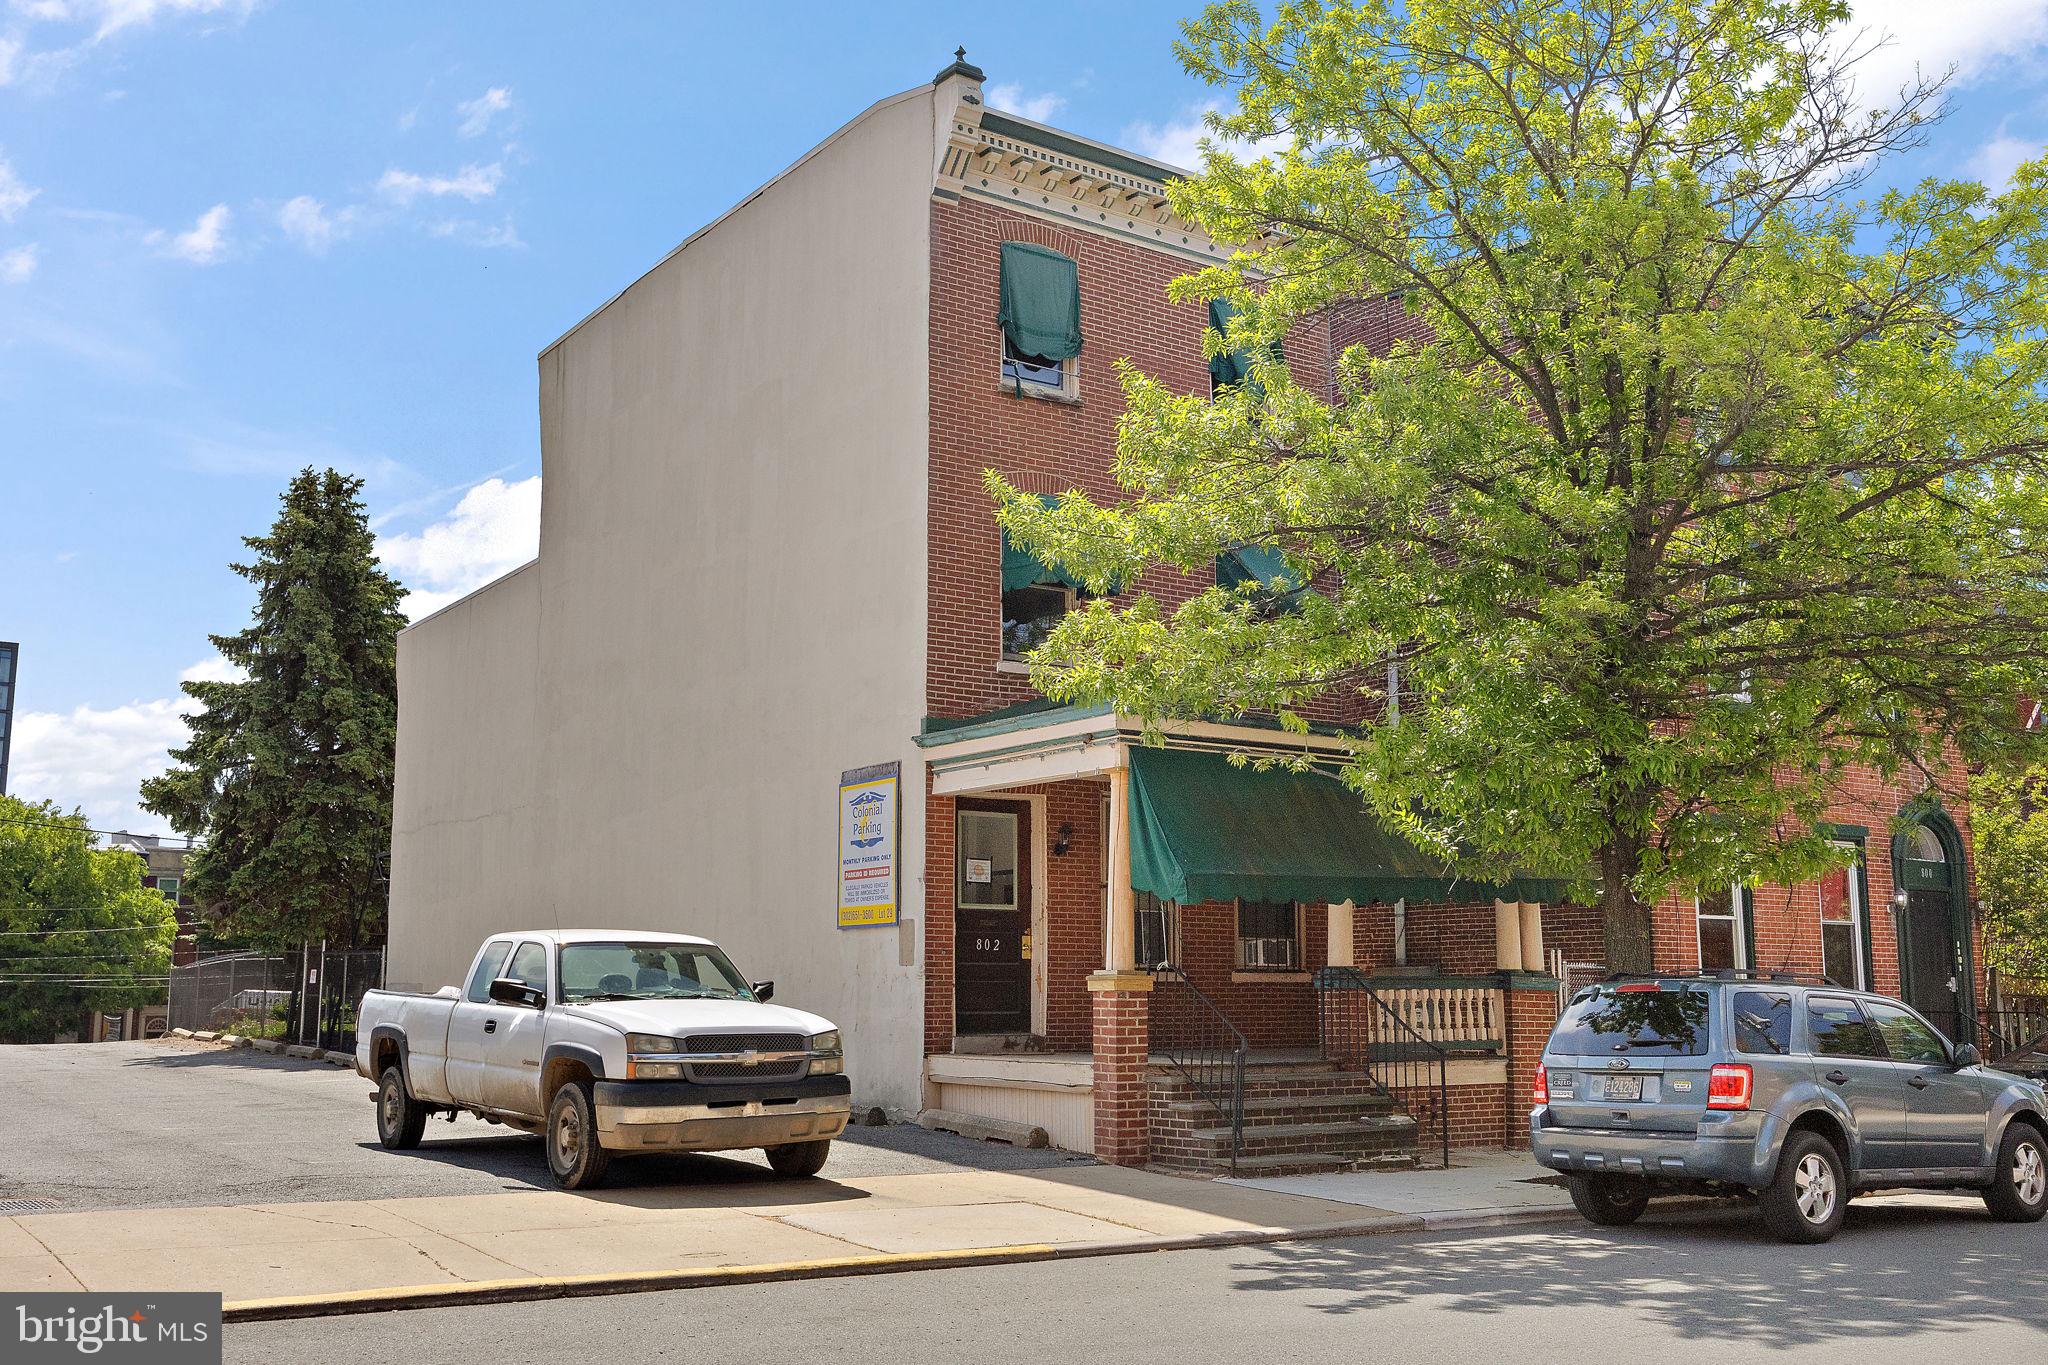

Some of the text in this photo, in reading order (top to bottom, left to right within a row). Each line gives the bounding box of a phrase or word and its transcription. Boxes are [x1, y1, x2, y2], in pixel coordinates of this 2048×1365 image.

[853, 803, 882, 818] Colonial
[853, 822, 882, 835] Parking
[976, 938, 1000, 951] 802
